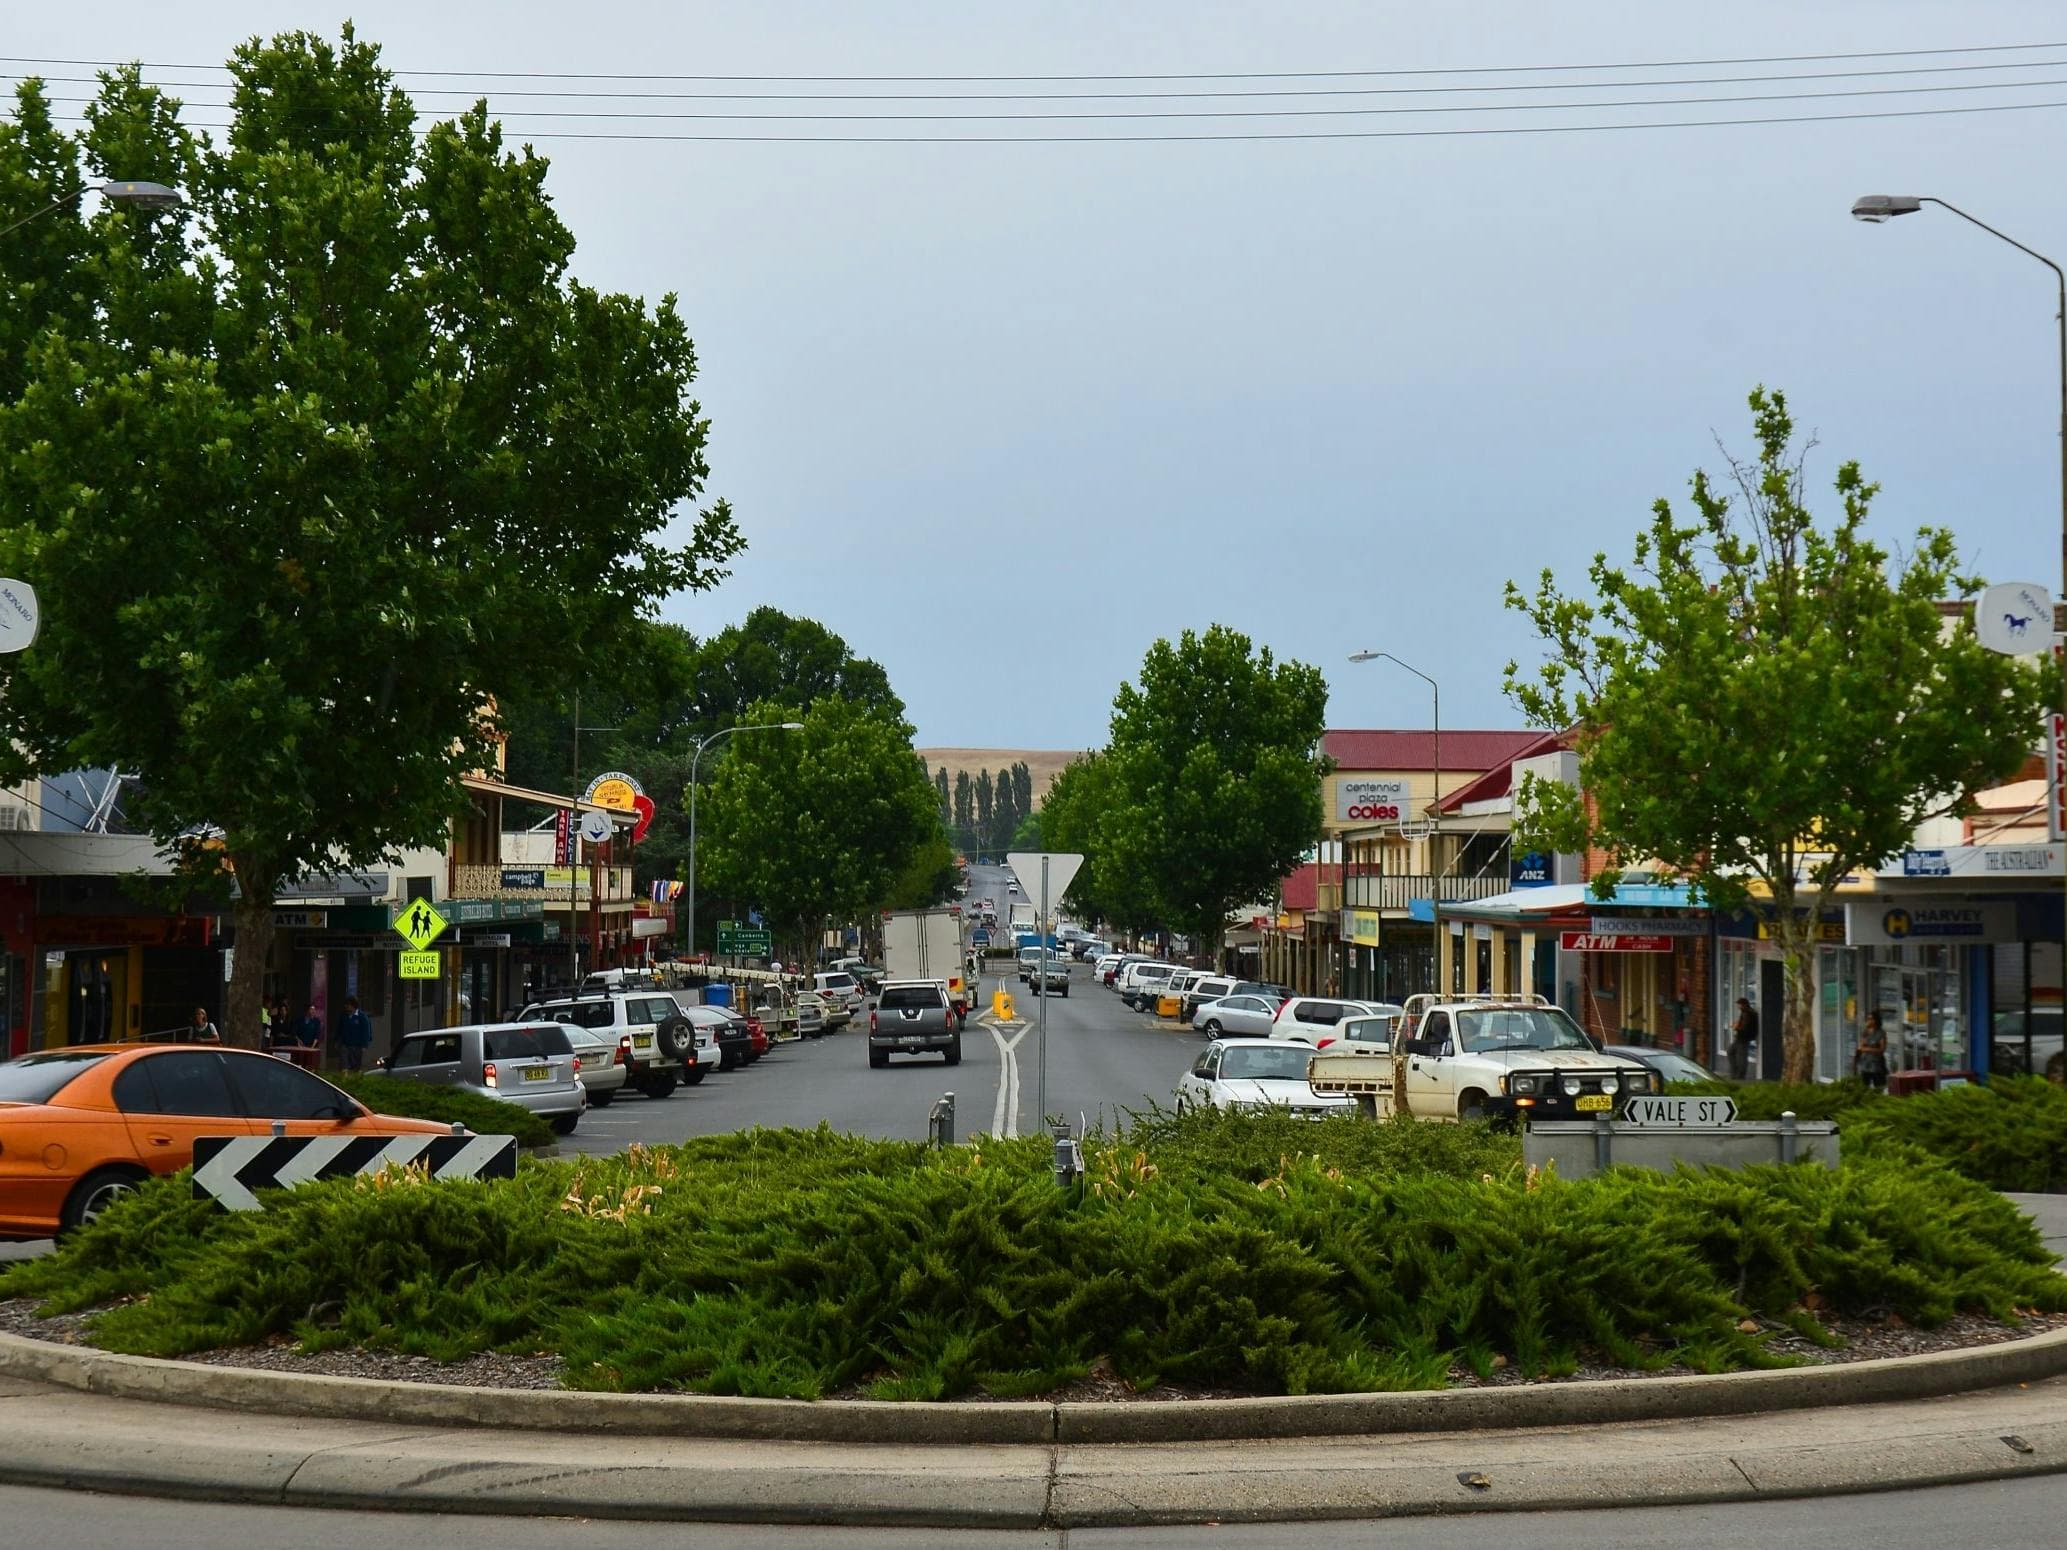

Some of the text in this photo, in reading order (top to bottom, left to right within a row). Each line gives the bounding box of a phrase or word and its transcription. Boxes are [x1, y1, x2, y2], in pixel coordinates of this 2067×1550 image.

[1, 588, 33, 621] MONARO
[1346, 781, 1401, 792] centennial
[1359, 794, 1388, 804] plaza
[1348, 803, 1399, 820] coles
[505, 873, 532, 882] campbell
[1519, 870, 1545, 880] ANZ
[275, 914, 307, 925] ATM
[1915, 910, 1983, 921] HARVEY
[1599, 921, 1703, 932] HOOKS PHARMACY
[1573, 934, 1617, 949] ATM
[402, 956, 436, 964] REFUGE
[403, 966, 436, 974] ISLAND
[1644, 1101, 1718, 1121] VALE ST
